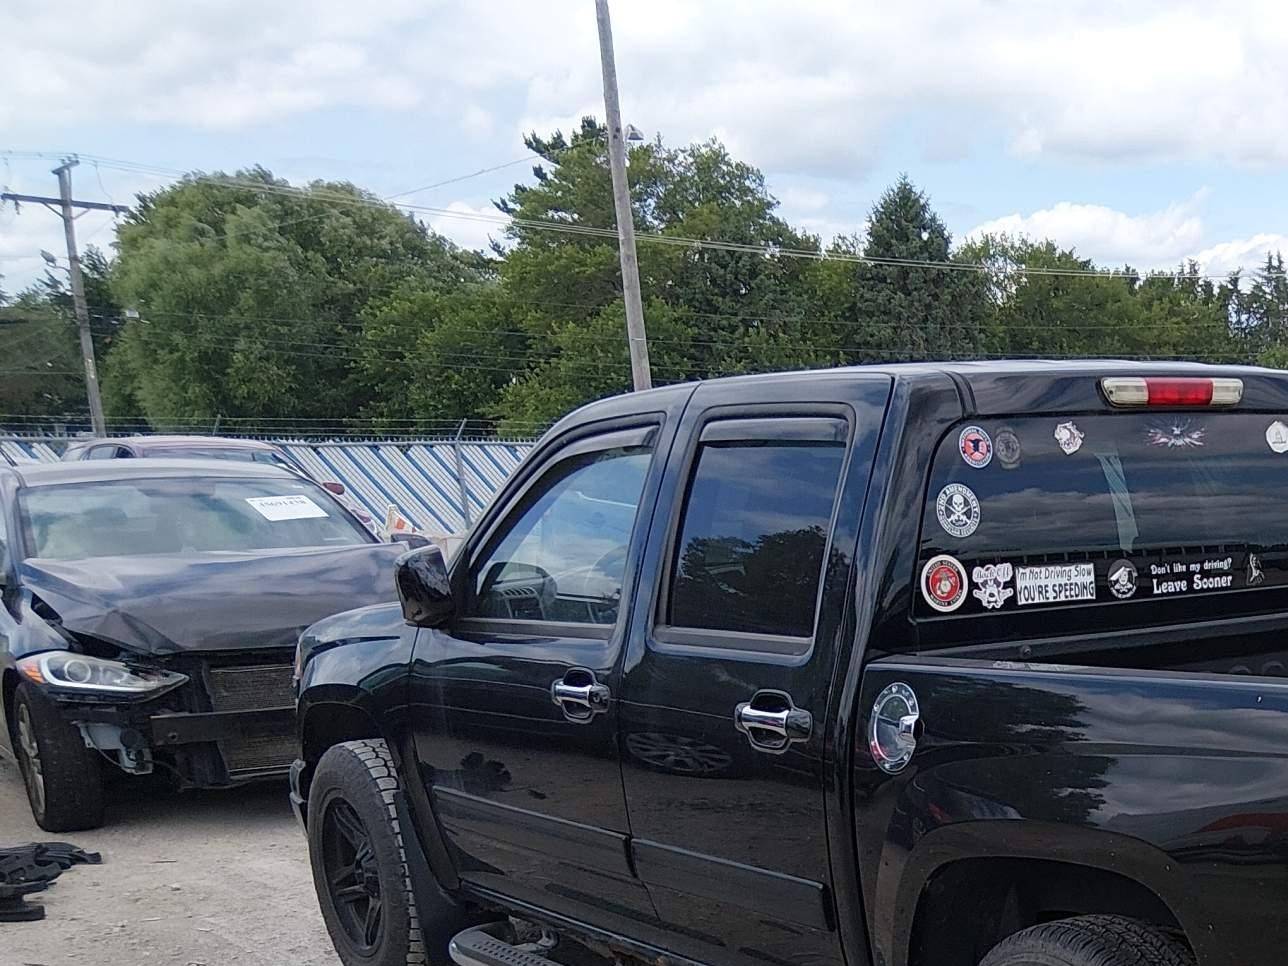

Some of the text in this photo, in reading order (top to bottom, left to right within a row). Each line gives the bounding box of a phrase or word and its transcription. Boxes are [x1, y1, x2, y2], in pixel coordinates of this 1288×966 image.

[1029, 569, 1043, 580] Not
[1045, 567, 1072, 581] Driving
[1075, 565, 1093, 577] Slow
[1151, 557, 1233, 575] Don't like my driving?
[1018, 583, 1051, 603] YOU'RE
[1051, 580, 1095, 601] SPEEDING
[1153, 577, 1188, 594] Leave
[1193, 573, 1233, 590] Sooner
